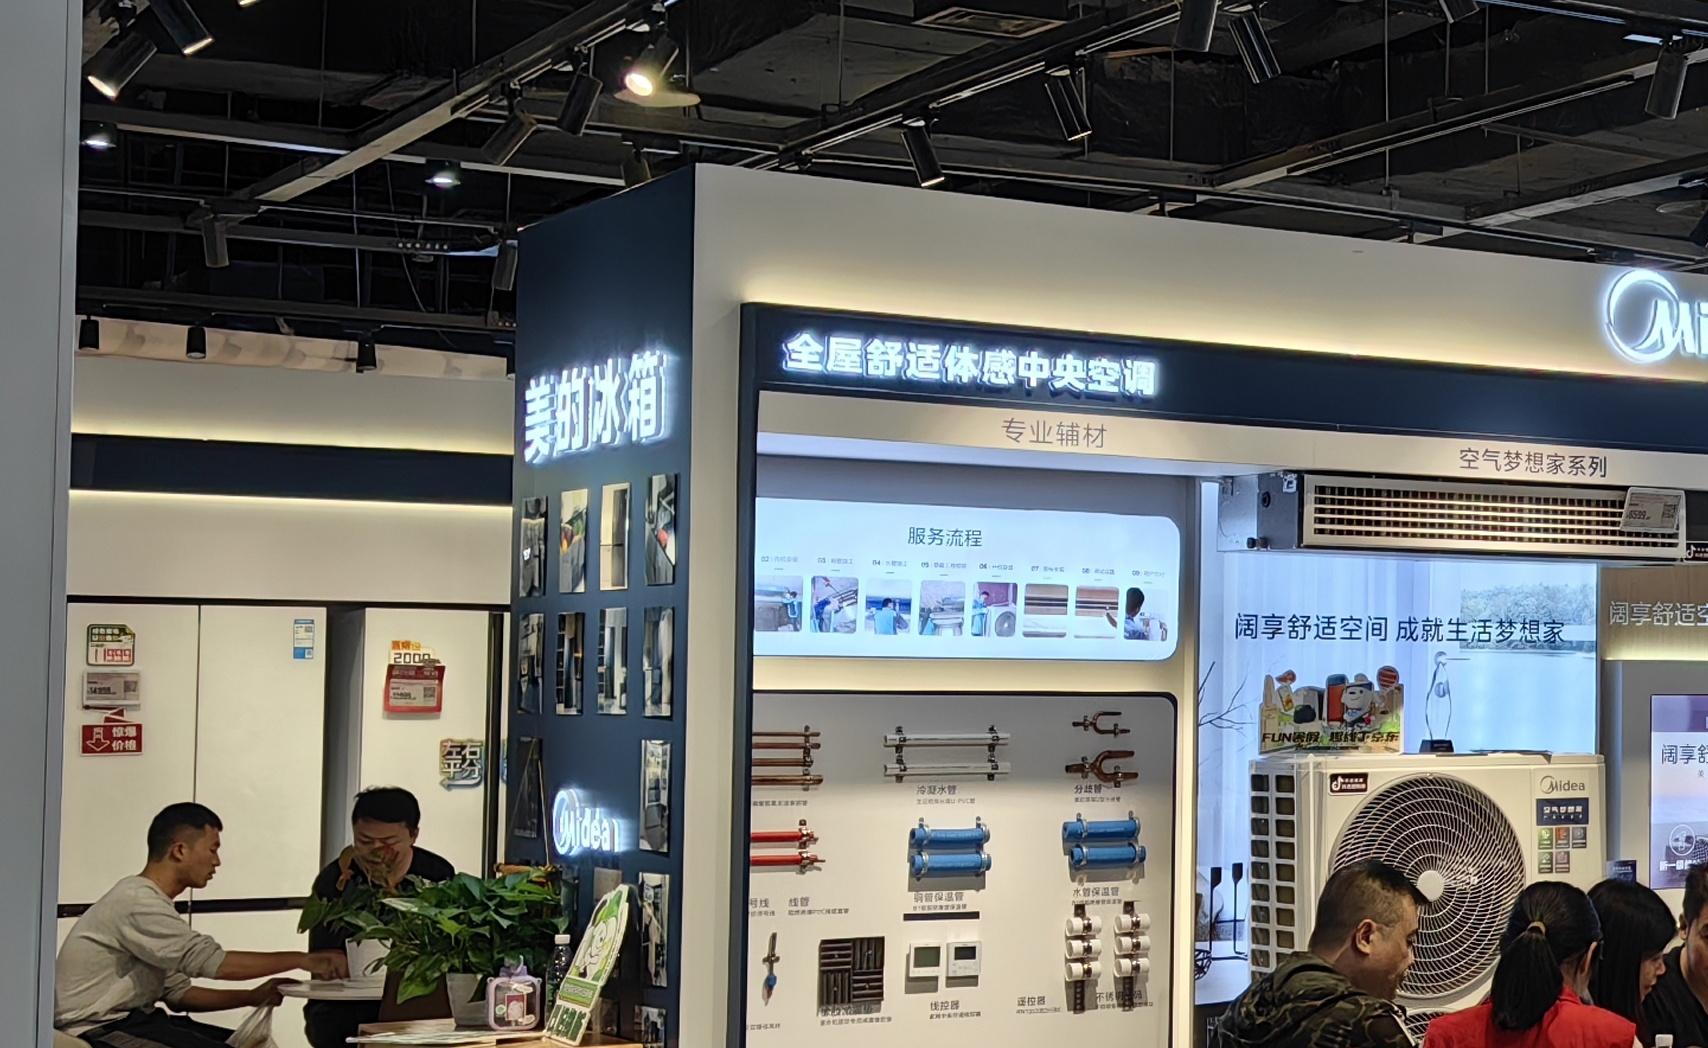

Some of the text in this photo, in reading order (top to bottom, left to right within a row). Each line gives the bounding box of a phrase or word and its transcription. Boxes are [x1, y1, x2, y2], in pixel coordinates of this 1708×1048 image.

[783, 332, 1157, 396] 全屋舒适体感中央空调
[524, 351, 668, 463] 美的冰箱
[1001, 418, 1107, 449] 专业辅材
[1460, 448, 1607, 478] 空气梦想家系列
[908, 526, 983, 548] 服务流程
[1235, 613, 1565, 645] 阔享舒适空间 成就生活梦想家
[441, 741, 483, 759] 左右
[441, 760, 482, 778] 平分
[1540, 775, 1585, 794] Midea
[553, 787, 623, 856] Midea
